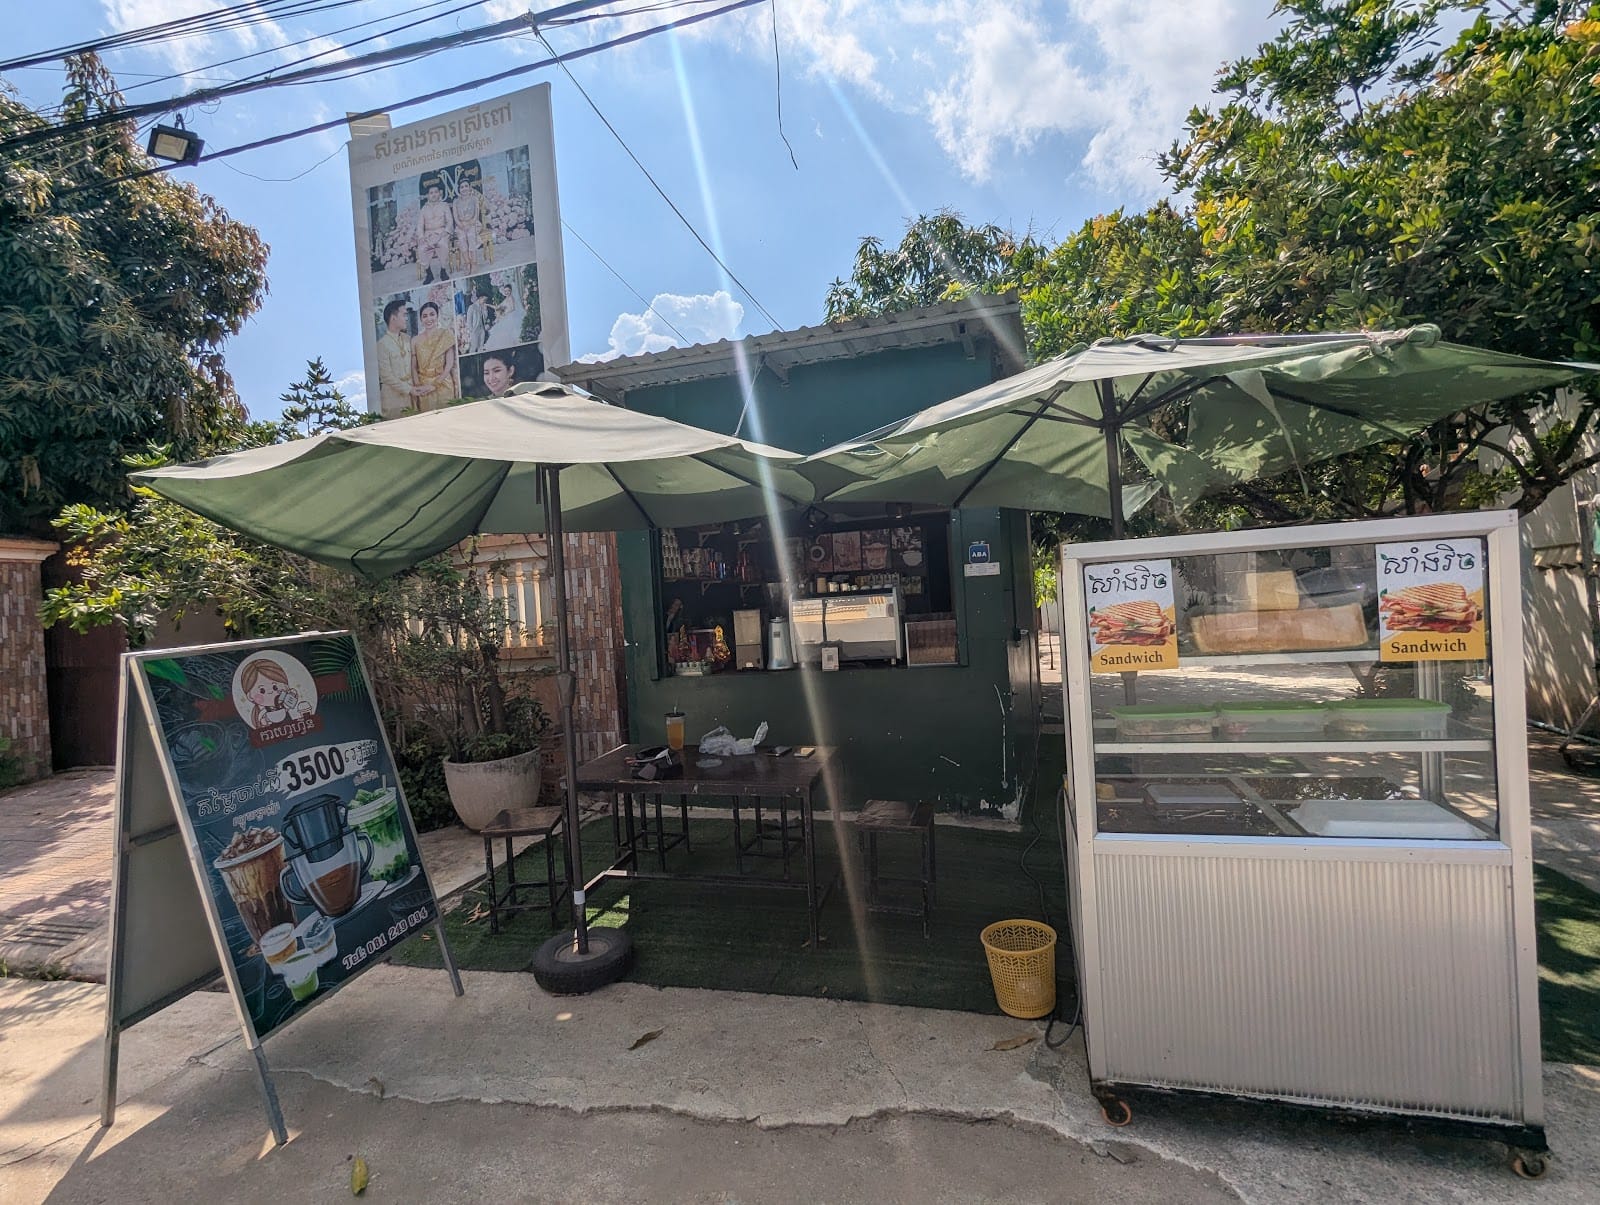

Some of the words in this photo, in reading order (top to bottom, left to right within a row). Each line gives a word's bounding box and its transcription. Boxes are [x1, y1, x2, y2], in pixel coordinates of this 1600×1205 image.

[1391, 639, 1467, 654] Sandwich
[1100, 650, 1163, 666] Sandwich
[197, 768, 281, 816] តម្លៃចាប់ពី
[282, 746, 345, 792] 3500
[366, 933, 388, 954] 081
